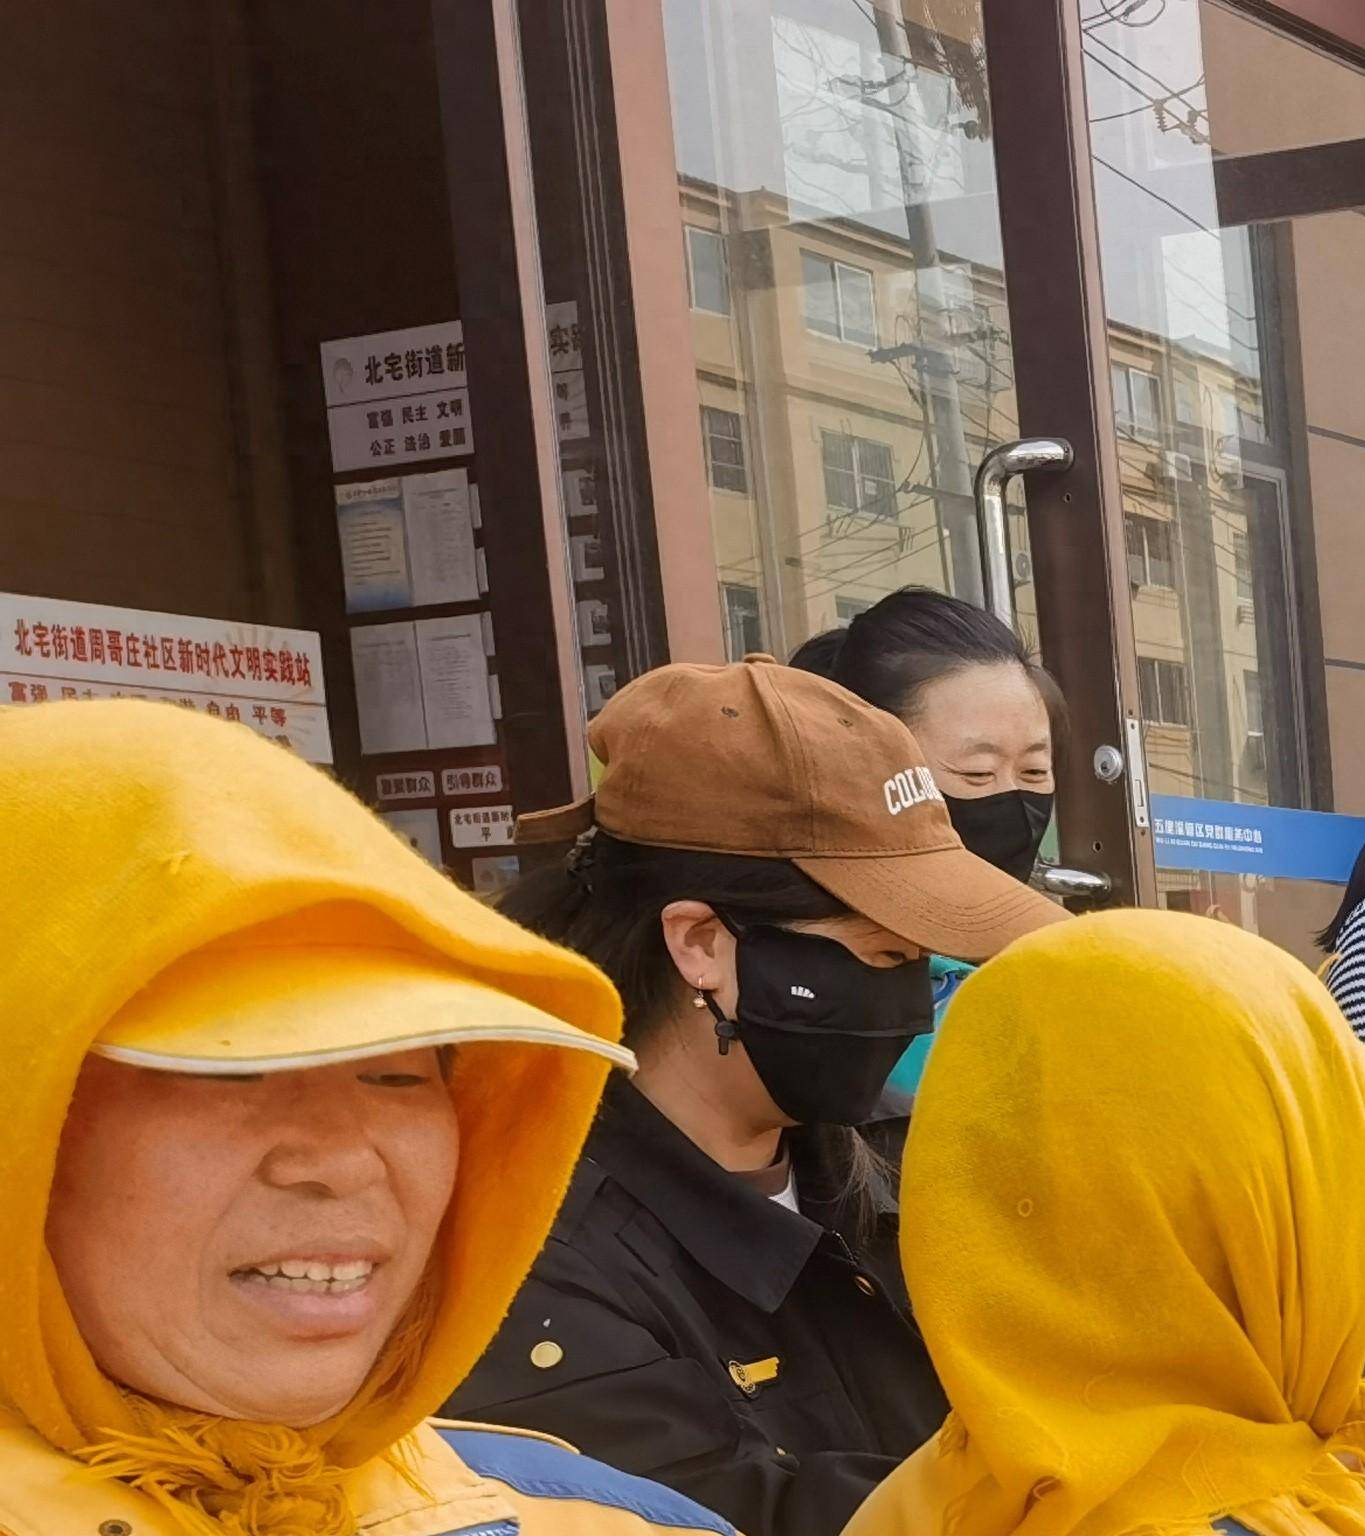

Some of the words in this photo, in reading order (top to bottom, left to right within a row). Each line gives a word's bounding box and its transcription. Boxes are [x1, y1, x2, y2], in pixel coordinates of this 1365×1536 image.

[13, 617, 312, 688] 北宅街道周哥庄社区新时代文明实践站
